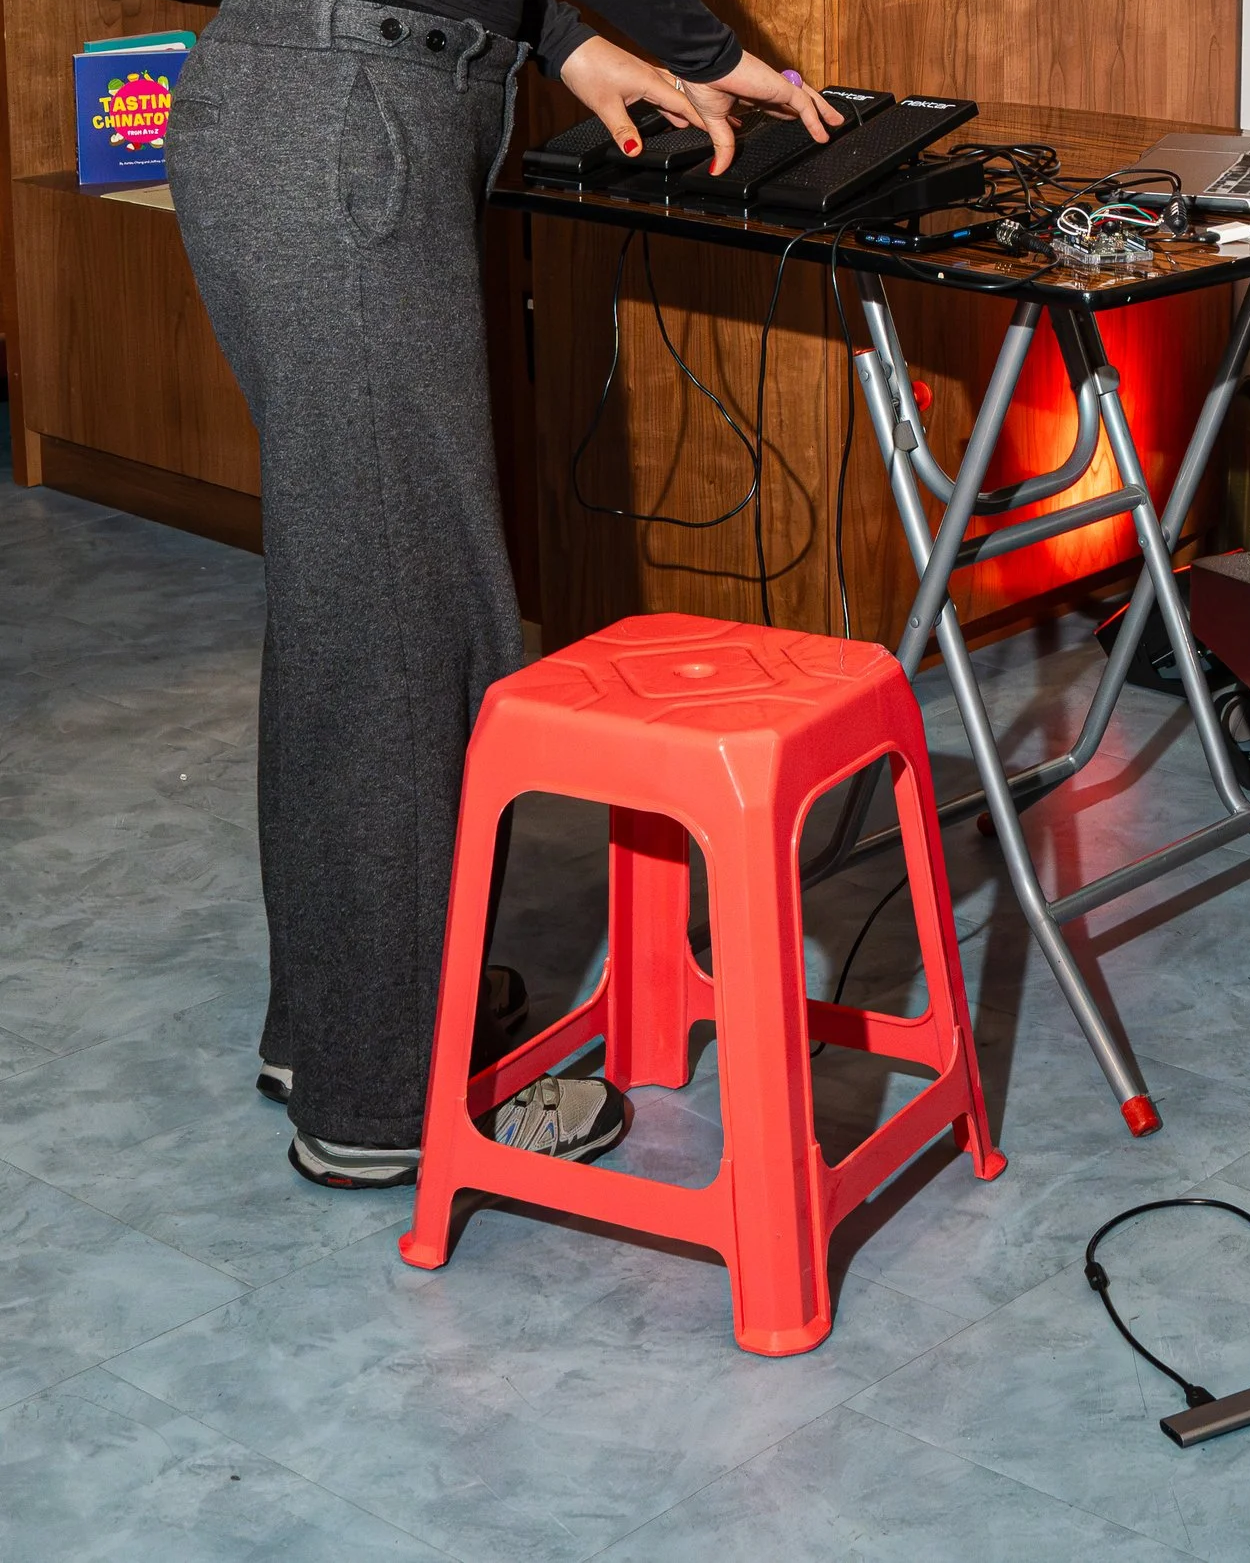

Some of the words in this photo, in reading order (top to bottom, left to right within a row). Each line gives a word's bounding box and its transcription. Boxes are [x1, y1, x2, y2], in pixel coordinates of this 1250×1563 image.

[99, 93, 173, 113] TASTIN
[900, 99, 957, 110] nektar
[92, 111, 170, 129] CHINATO
